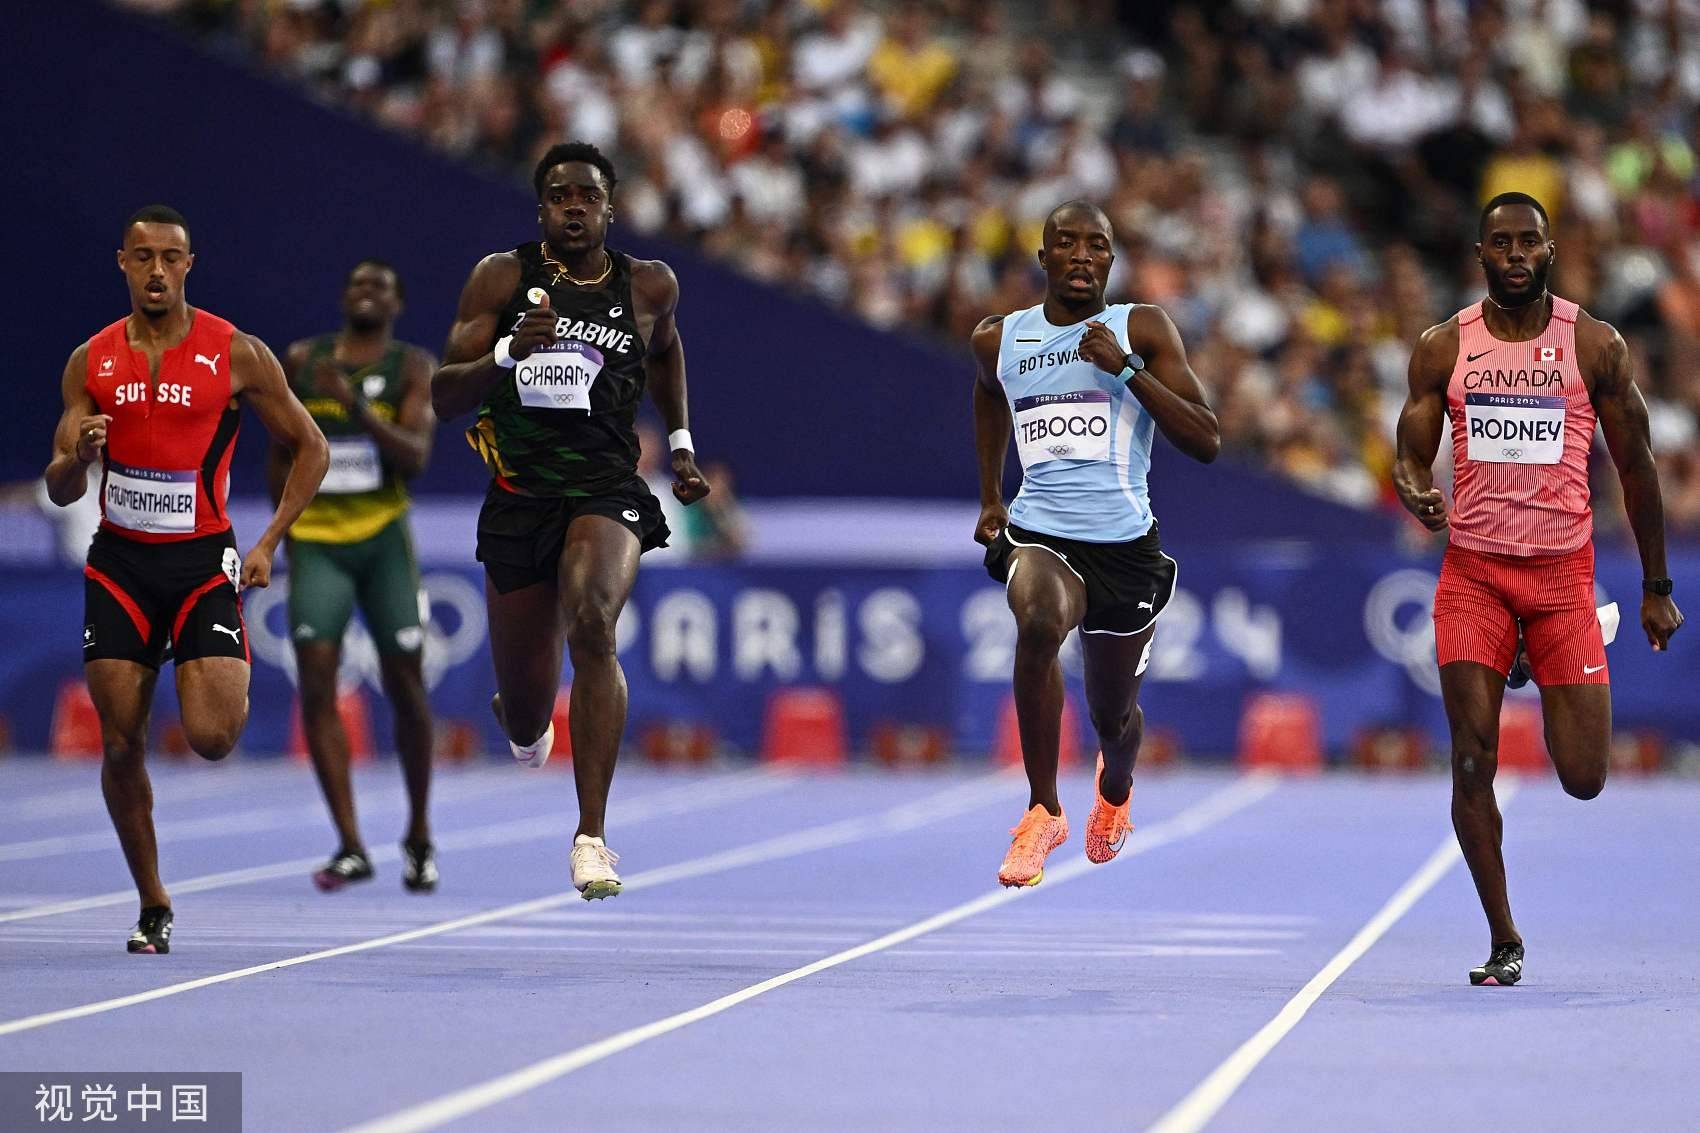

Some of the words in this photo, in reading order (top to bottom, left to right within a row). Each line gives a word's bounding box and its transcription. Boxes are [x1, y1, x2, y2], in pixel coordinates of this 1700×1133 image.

[510, 312, 633, 353] ZBABWE
[1019, 349, 1081, 375] BOTSWA
[1463, 370, 1565, 389] CANADA
[1035, 395, 1058, 403] PARIS
[1060, 393, 1084, 401] 2024
[1490, 396, 1515, 404] PARIS
[1517, 397, 1540, 405] 2024
[1021, 416, 1107, 444] TEBOGO
[1471, 418, 1562, 441] RODNEY
[107, 484, 193, 514] MUMENTHALER
